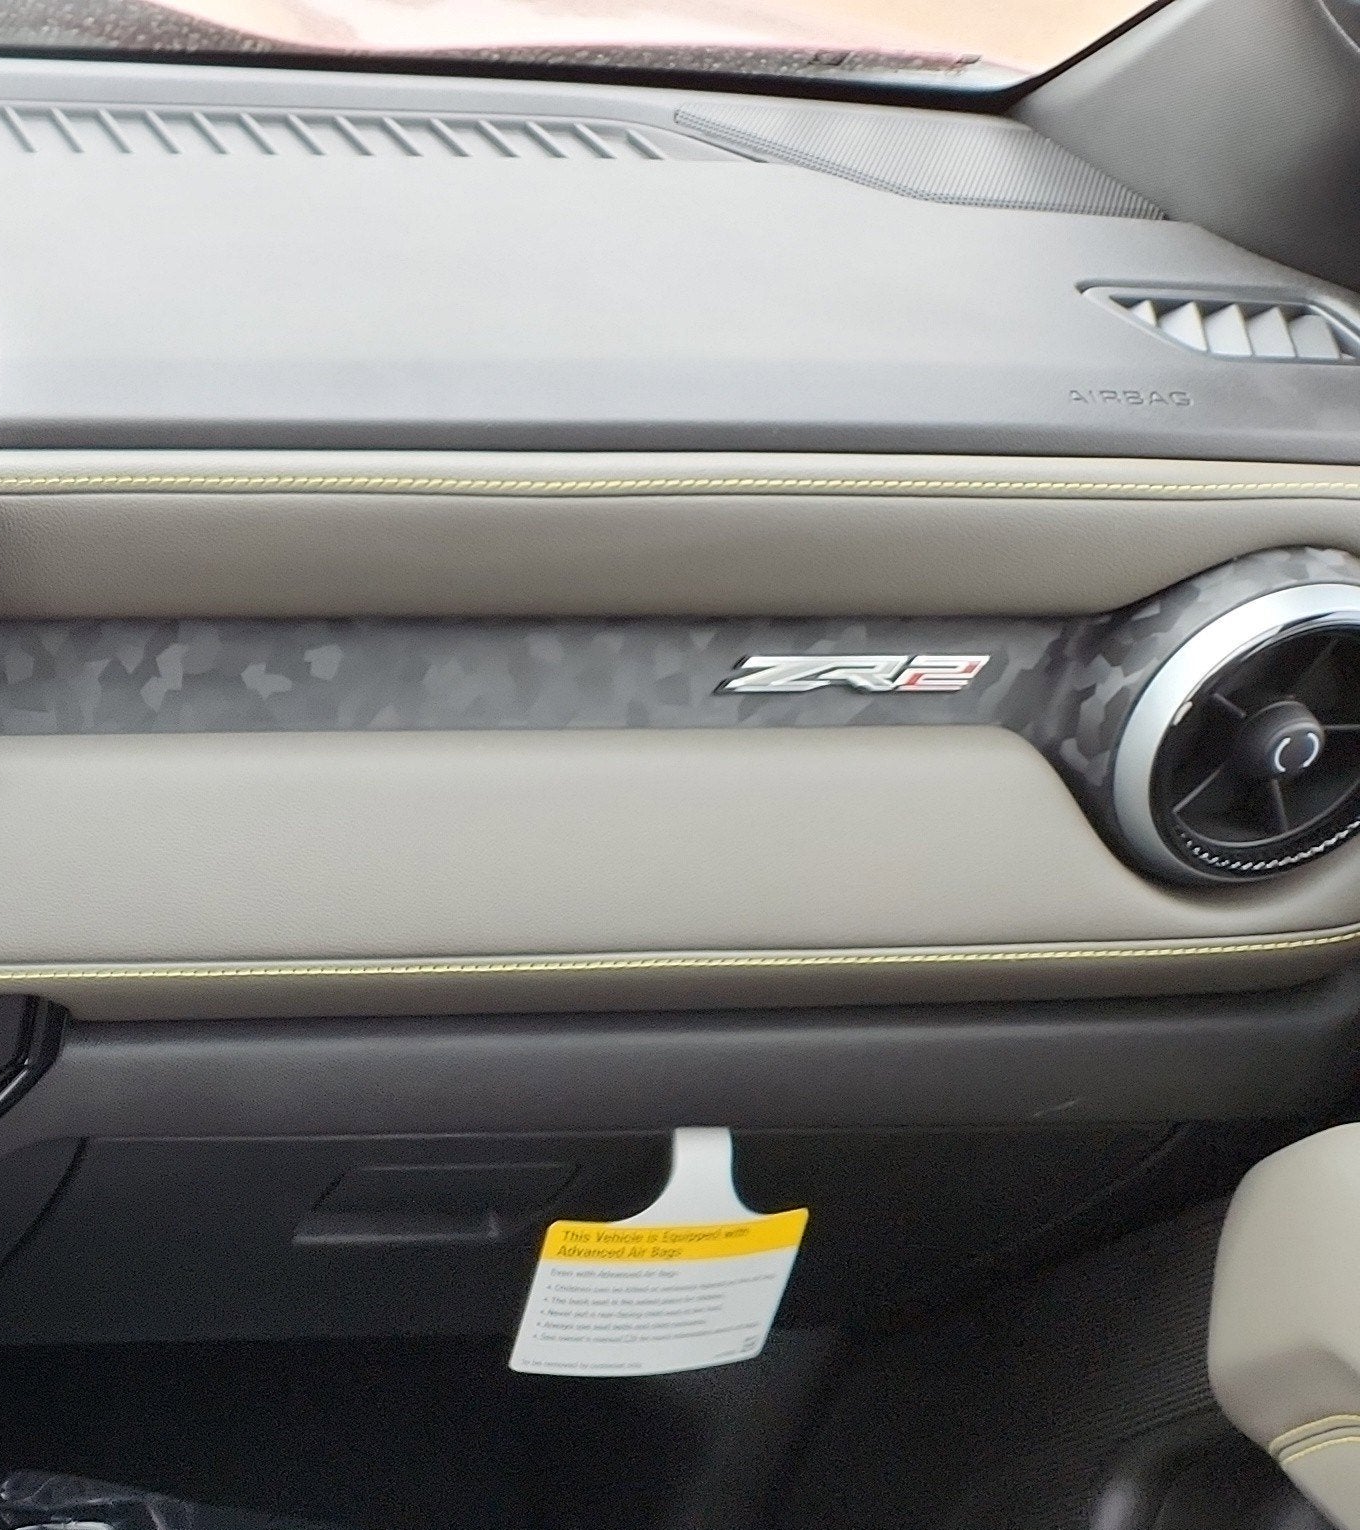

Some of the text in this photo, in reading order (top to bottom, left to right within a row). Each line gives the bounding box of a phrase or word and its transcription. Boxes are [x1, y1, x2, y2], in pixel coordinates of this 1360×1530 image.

[1069, 390, 1194, 407] AIRBAG
[720, 655, 991, 693] ZR2
[562, 1230, 591, 1243] This
[596, 1230, 644, 1243] Vehicle
[557, 1245, 626, 1259] Advanced
[627, 1246, 645, 1258] Air
